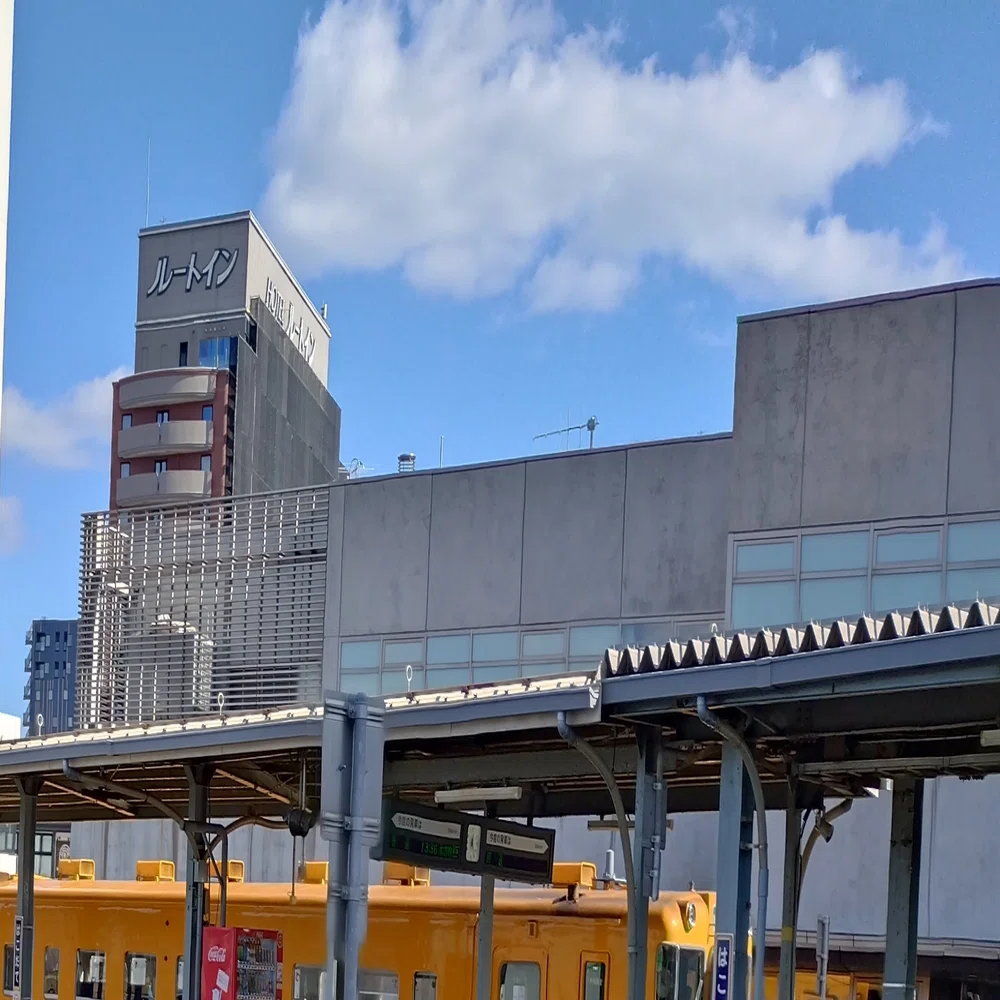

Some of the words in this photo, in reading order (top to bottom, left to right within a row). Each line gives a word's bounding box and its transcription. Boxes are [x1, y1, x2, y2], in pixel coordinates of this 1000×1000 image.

[146, 248, 239, 298] ルートイン
